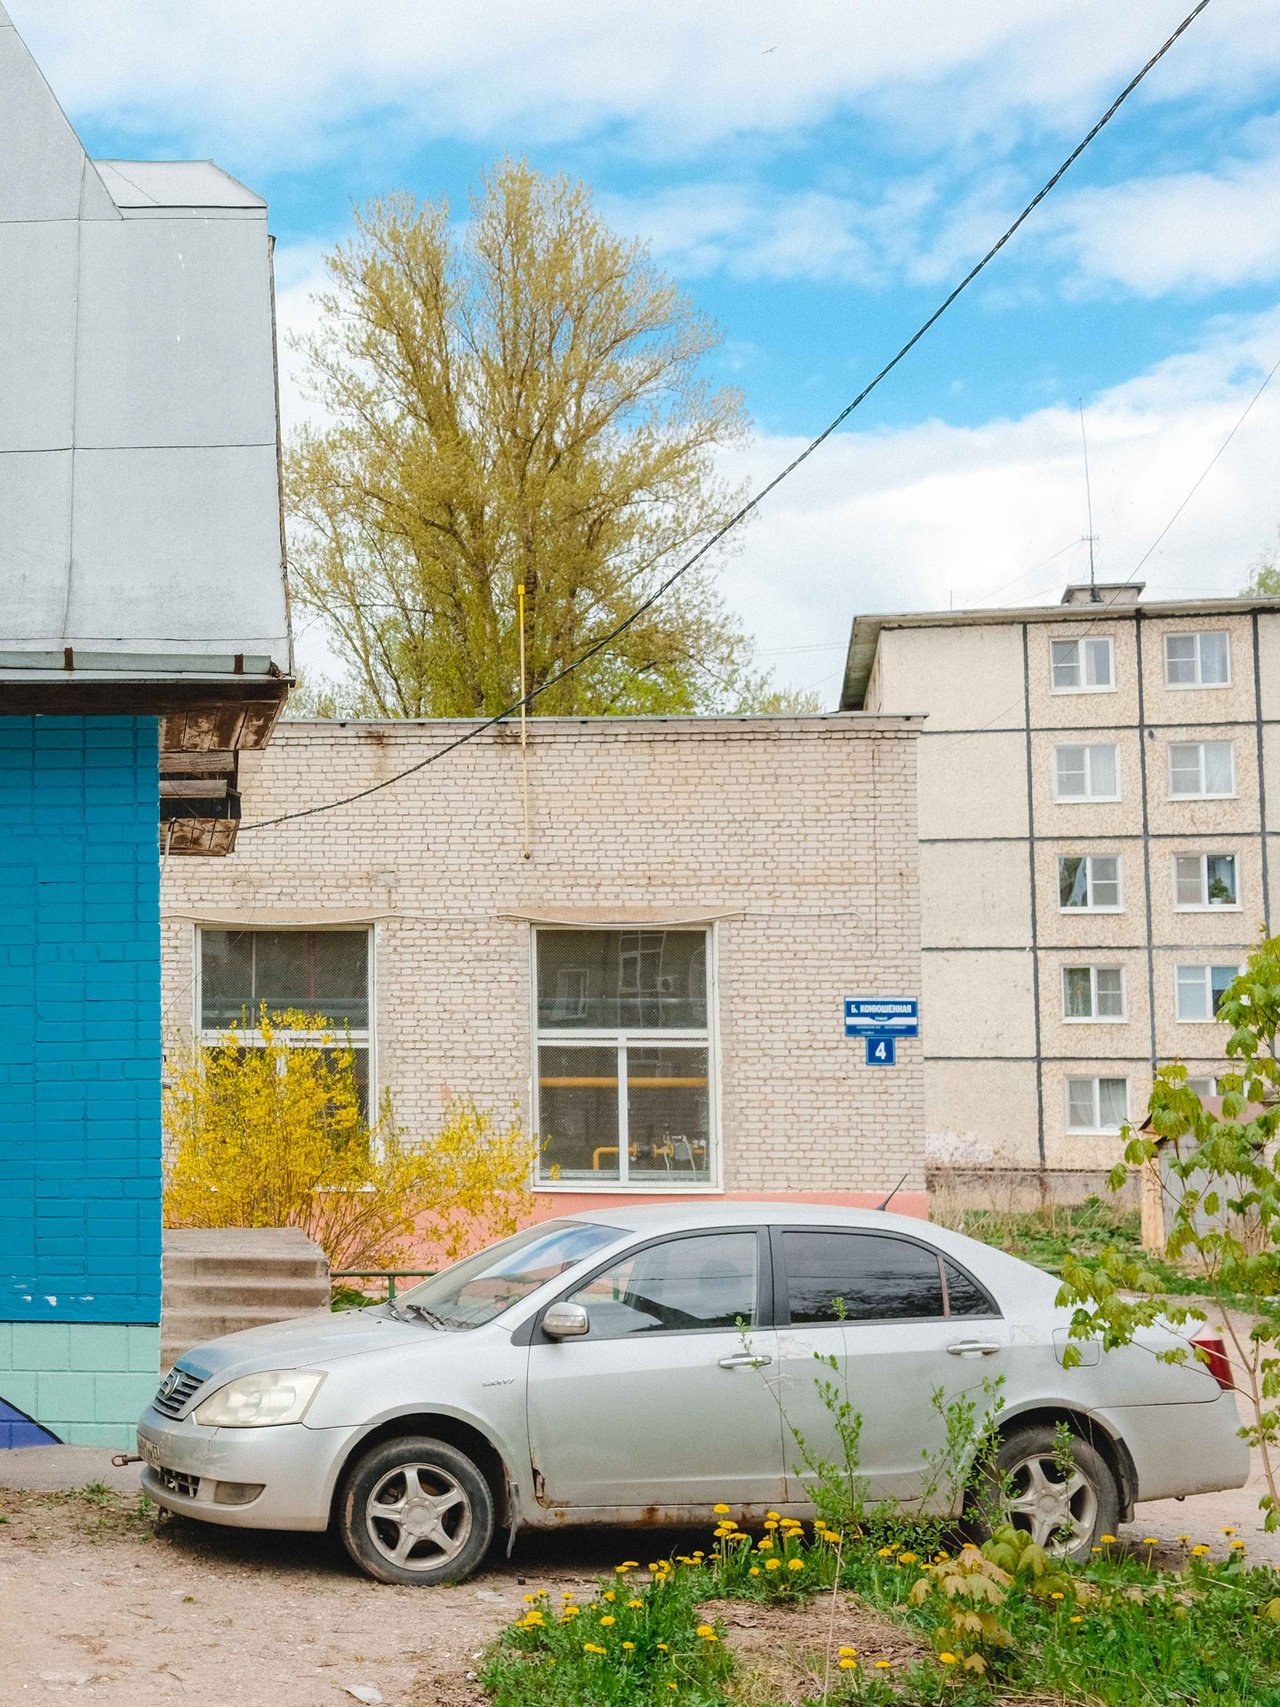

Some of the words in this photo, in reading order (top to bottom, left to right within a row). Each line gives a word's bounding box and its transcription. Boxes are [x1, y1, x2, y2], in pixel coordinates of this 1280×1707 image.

[851, 1004, 858, 1013] Б.
[860, 1004, 912, 1013] КОНЮШЕННАЯ
[875, 1041, 887, 1060] 4
